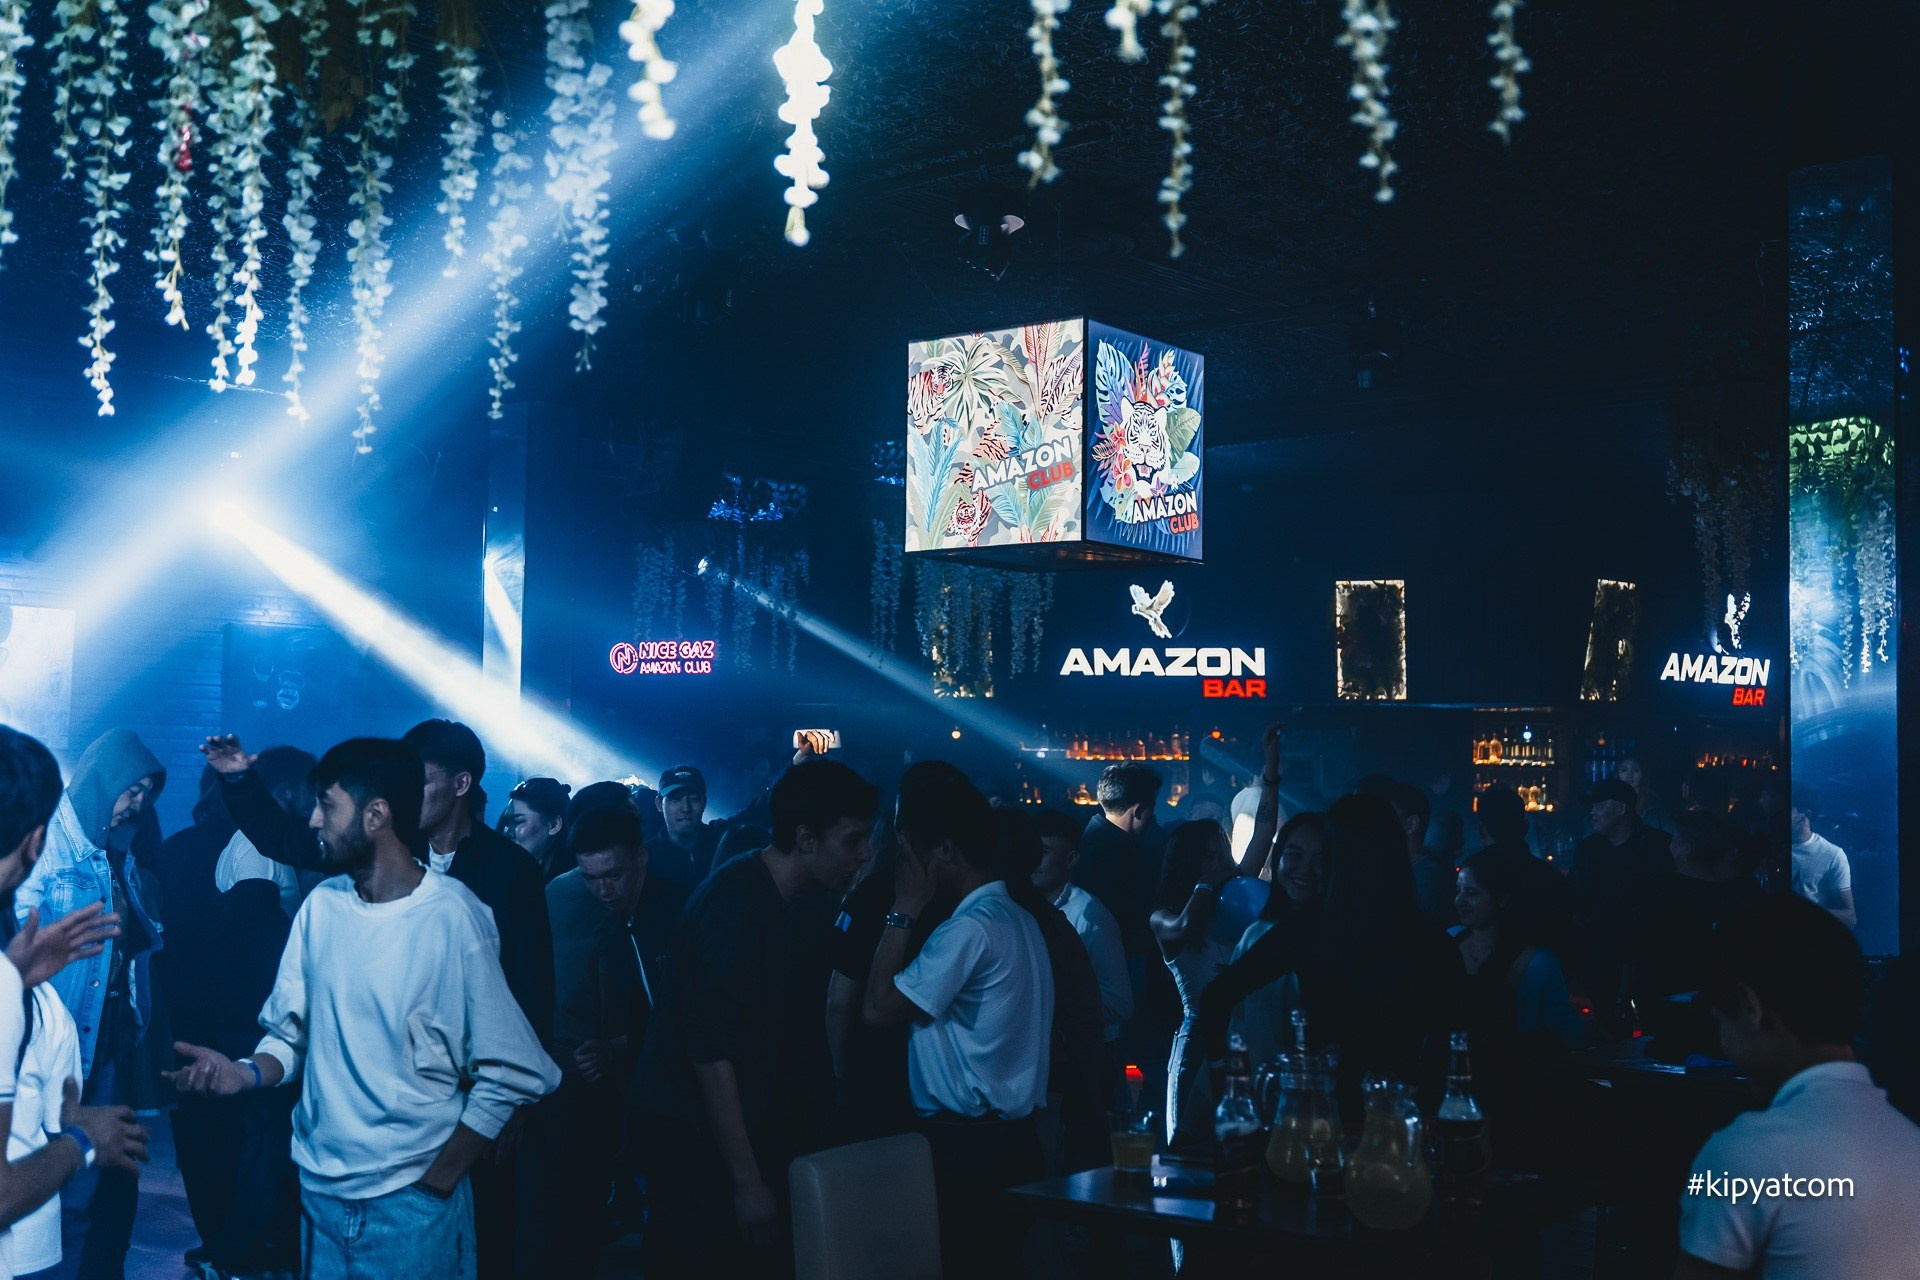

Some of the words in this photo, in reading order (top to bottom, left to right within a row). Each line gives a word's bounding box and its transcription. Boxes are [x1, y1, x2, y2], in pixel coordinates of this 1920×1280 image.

[971, 437, 1073, 492] AMAZON
[1027, 461, 1075, 490] CLUB
[1131, 491, 1198, 524] AMAZON
[1169, 513, 1199, 533] CLUB
[639, 641, 677, 659] NICE
[679, 640, 715, 659] GAZ
[640, 661, 681, 674] AMAZON
[684, 660, 712, 674] CLUB
[1060, 647, 1266, 677] AMAZON
[1660, 652, 1771, 686] AMAZON
[1202, 678, 1267, 698] BAR
[1732, 687, 1766, 706] BAR
